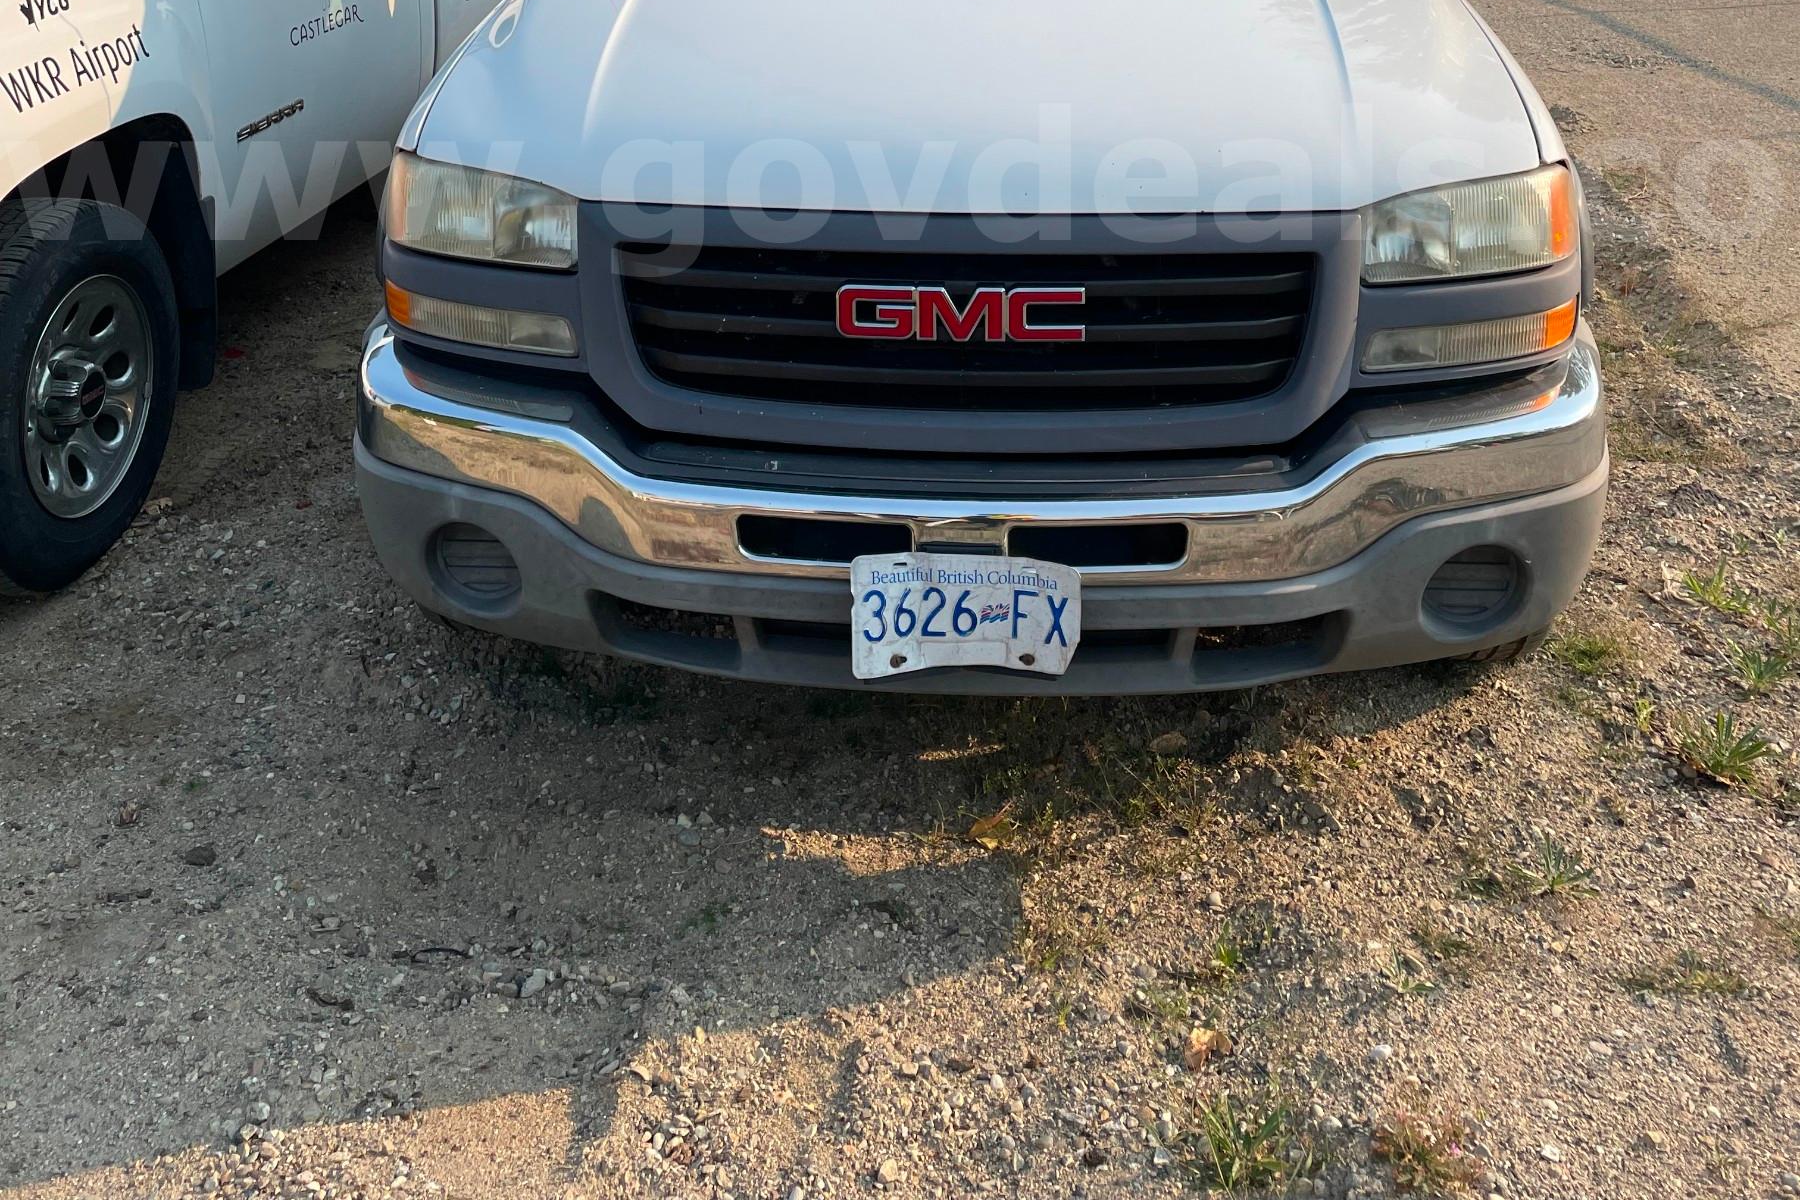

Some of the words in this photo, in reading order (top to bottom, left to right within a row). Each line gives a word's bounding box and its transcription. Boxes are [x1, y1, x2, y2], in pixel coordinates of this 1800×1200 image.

[289, 4, 365, 46] CASTLEGAR
[0, 57, 69, 113] WKR
[70, 24, 150, 87] Airport
[236, 98, 304, 143] SIERRA
[836, 284, 1085, 342] GMC
[871, 567, 933, 584] Beautiful
[938, 569, 984, 585] British
[987, 571, 1058, 590] Columbia
[862, 587, 978, 642] 3626
[1011, 589, 1069, 647] FX
